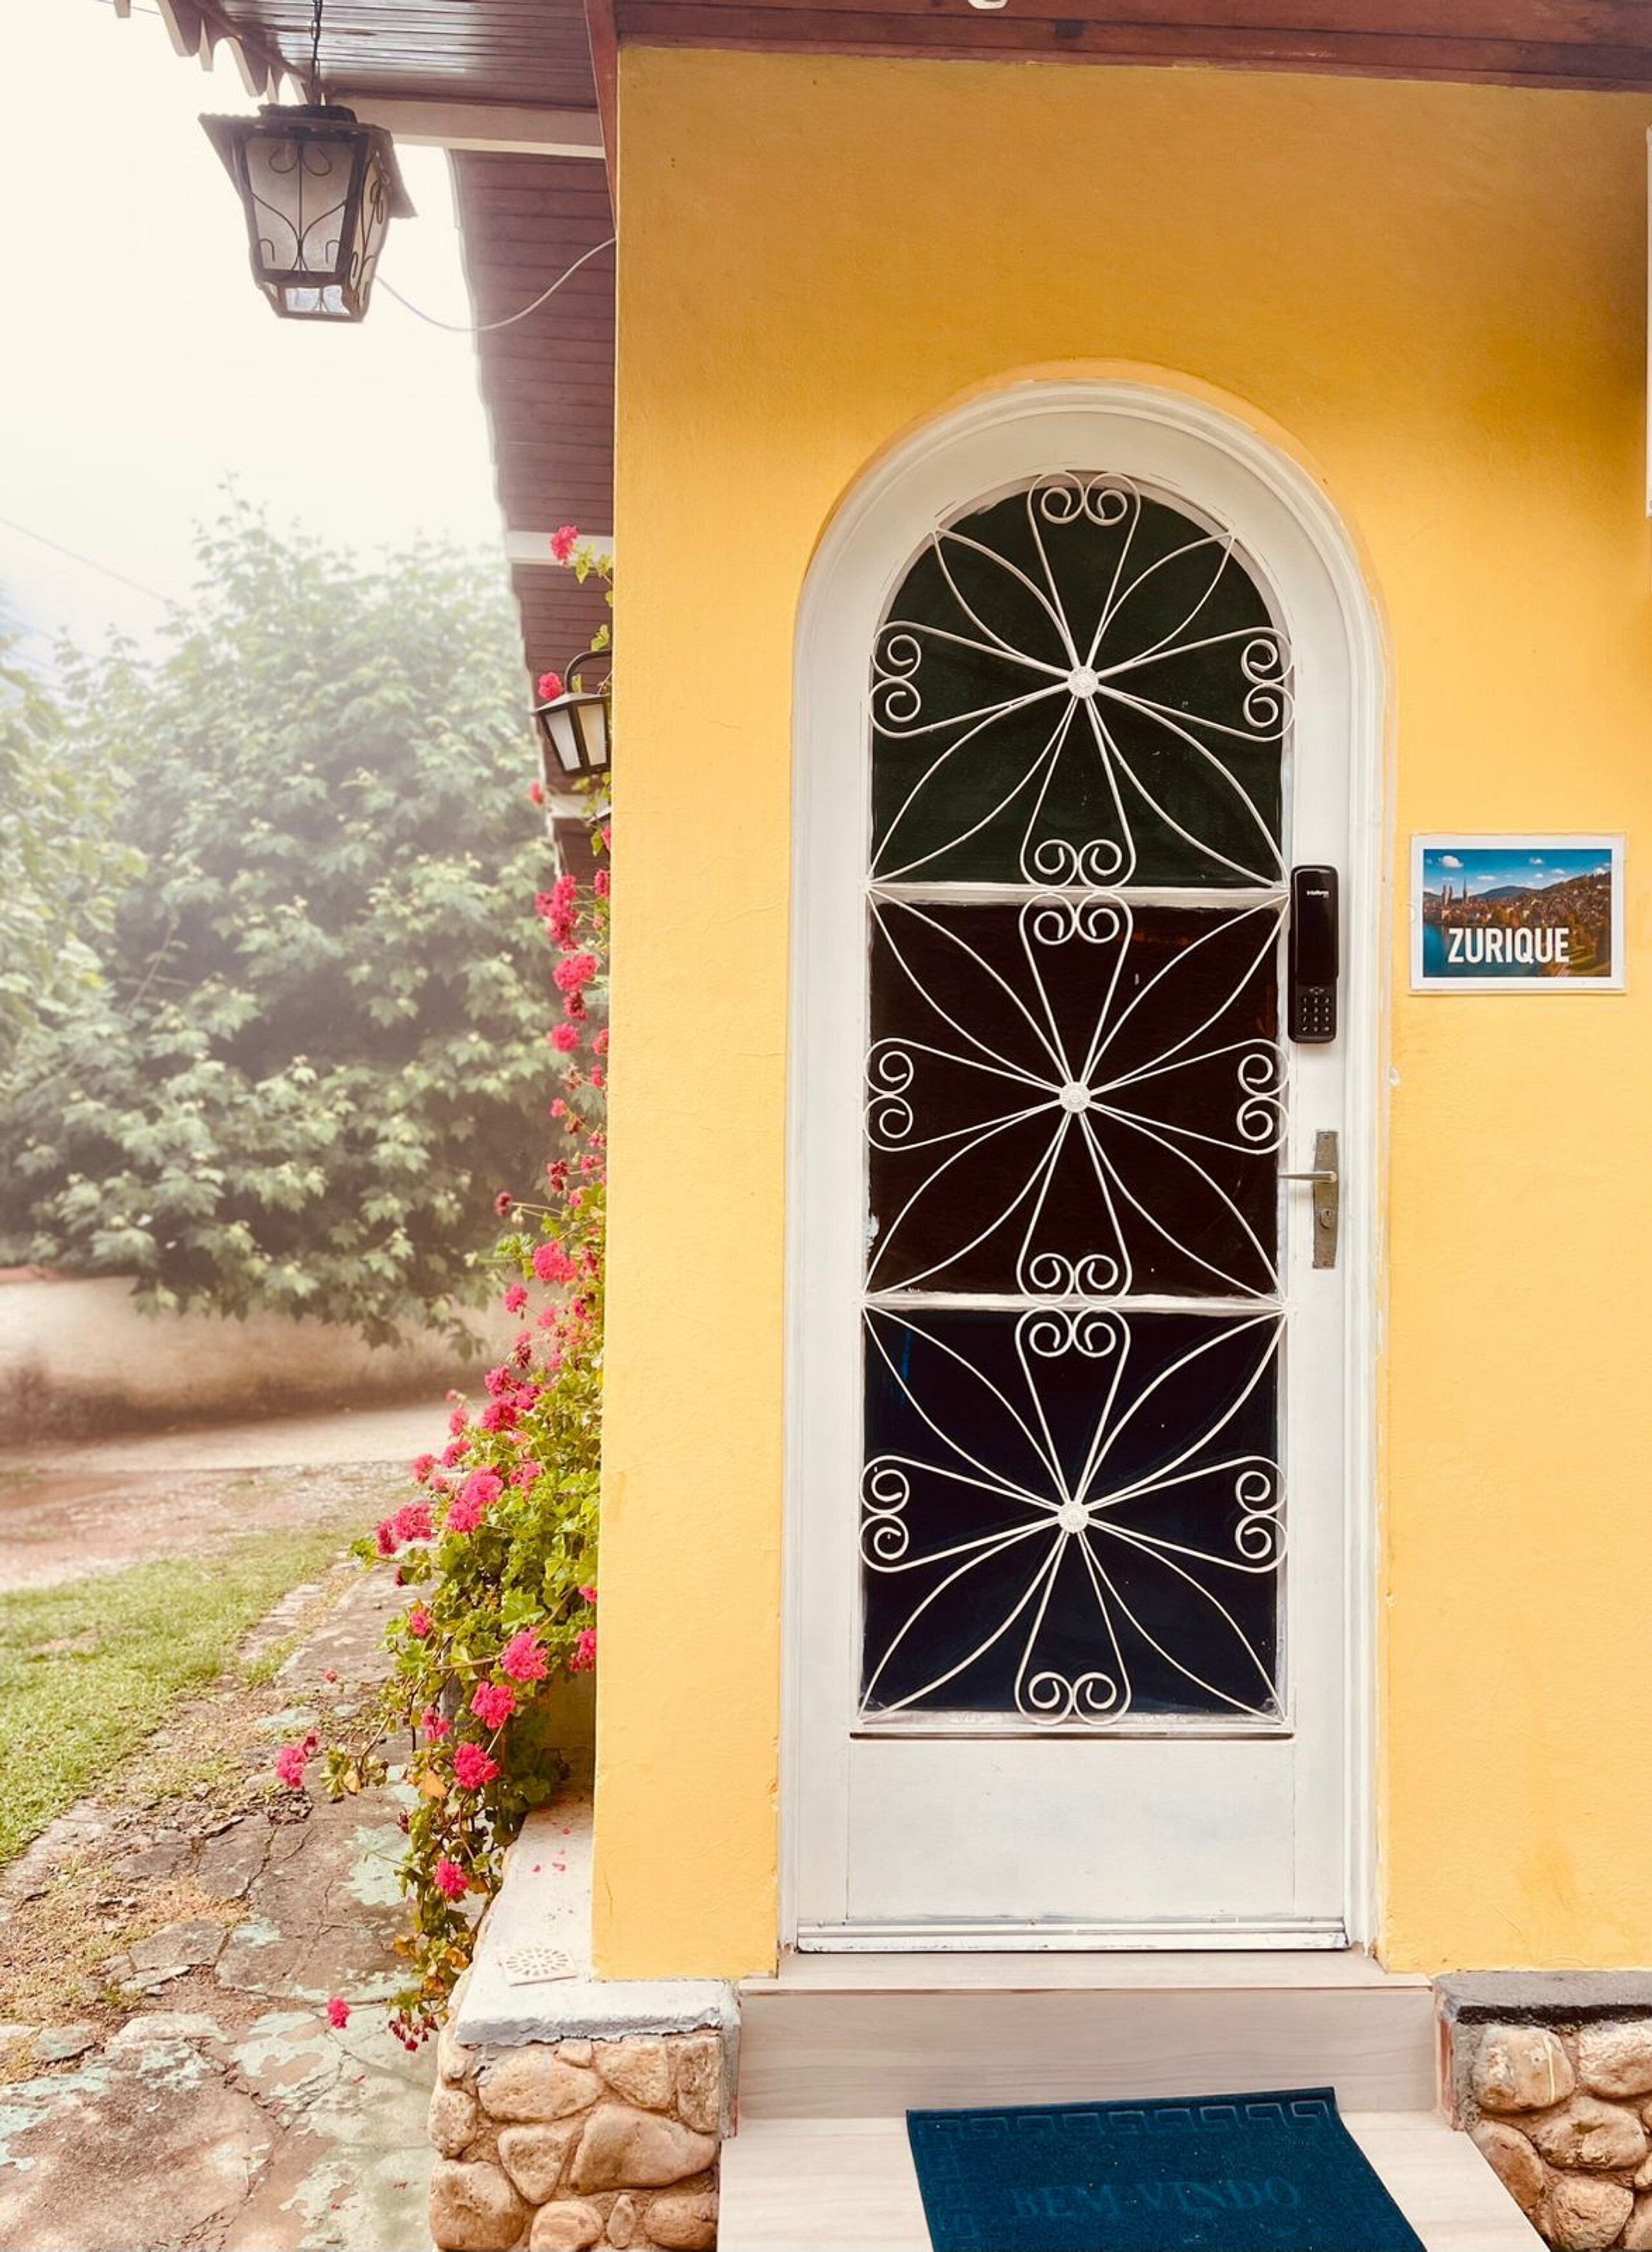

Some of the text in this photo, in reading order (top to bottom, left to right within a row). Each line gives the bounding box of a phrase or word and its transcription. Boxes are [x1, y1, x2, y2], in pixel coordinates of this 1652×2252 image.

[1447, 928, 1570, 964] ZURIQUE
[1007, 2175, 1302, 2219] BEM VINDO
